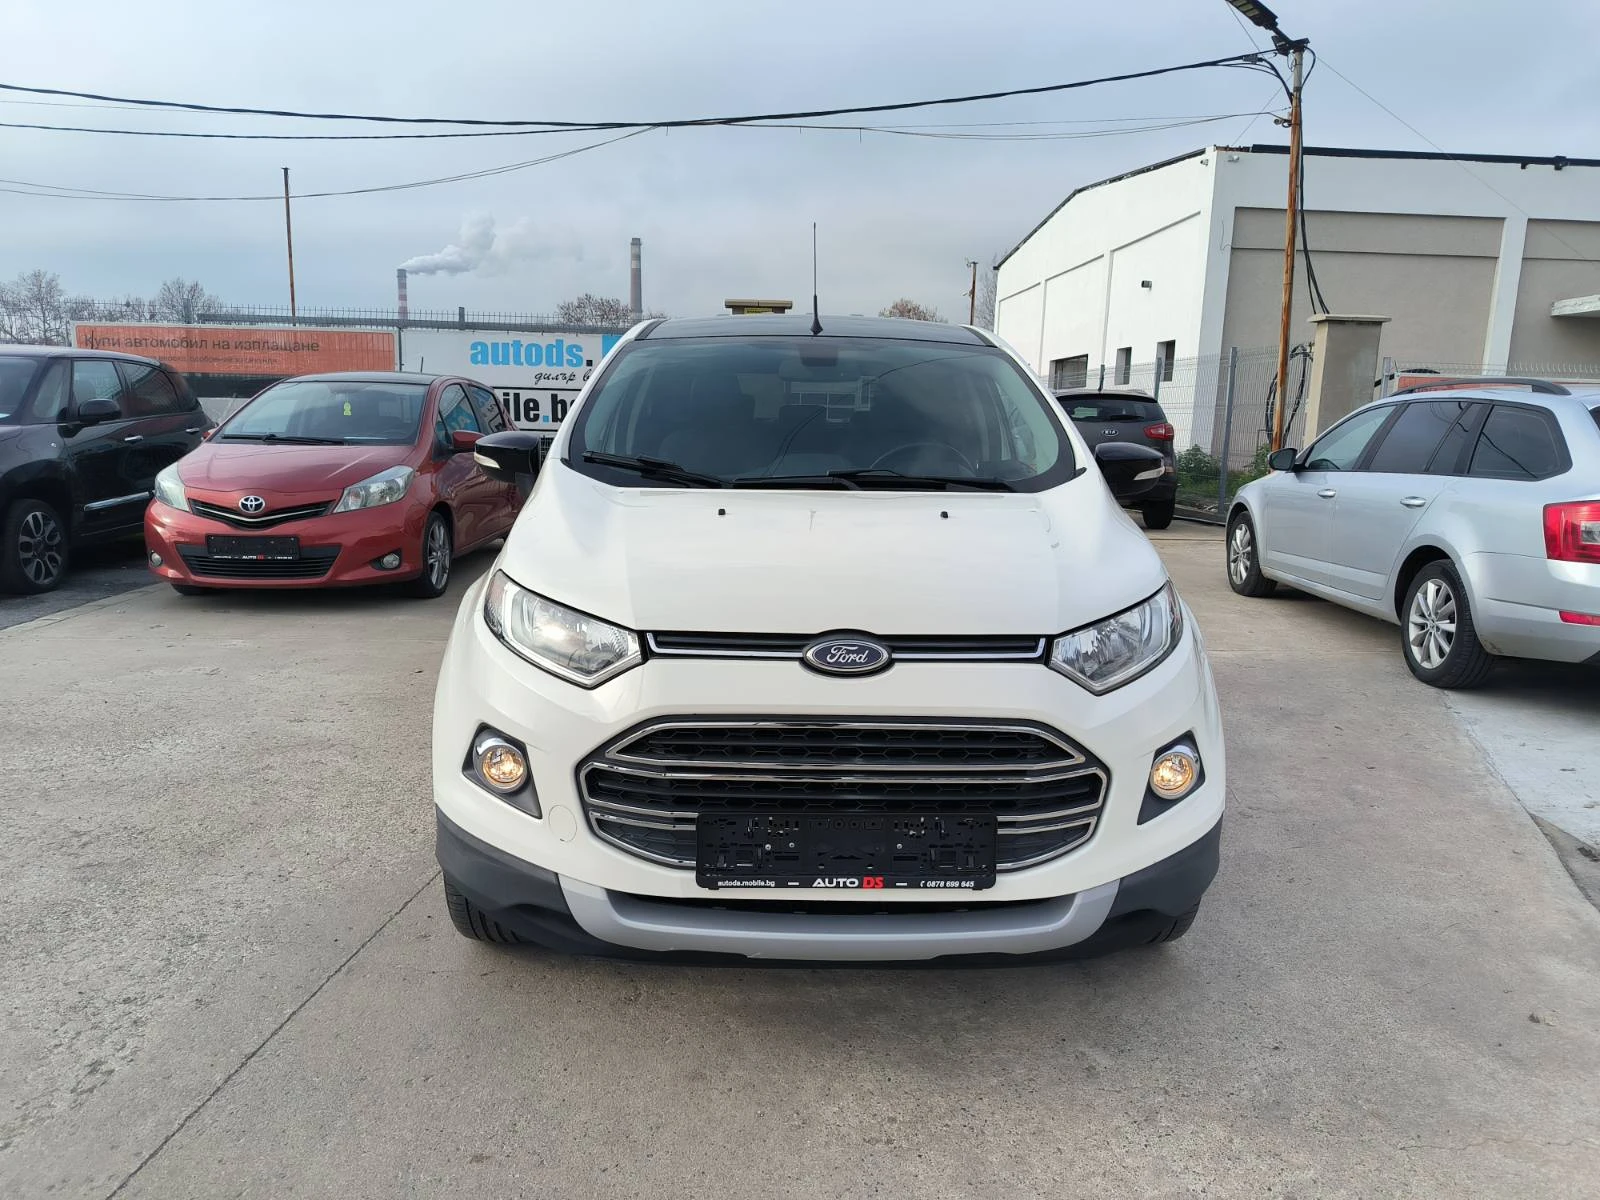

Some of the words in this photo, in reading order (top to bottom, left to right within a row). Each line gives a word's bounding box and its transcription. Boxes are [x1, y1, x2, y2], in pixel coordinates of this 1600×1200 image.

[84, 334, 121, 349] Купи
[125, 336, 208, 349] автомобил
[213, 340, 230, 350] на
[234, 340, 320, 352] изплащане
[470, 339, 593, 368] autods.
[534, 371, 576, 385] дилър
[826, 645, 869, 663] Ford
[812, 878, 859, 888] AUTO
[862, 876, 884, 889] DS
